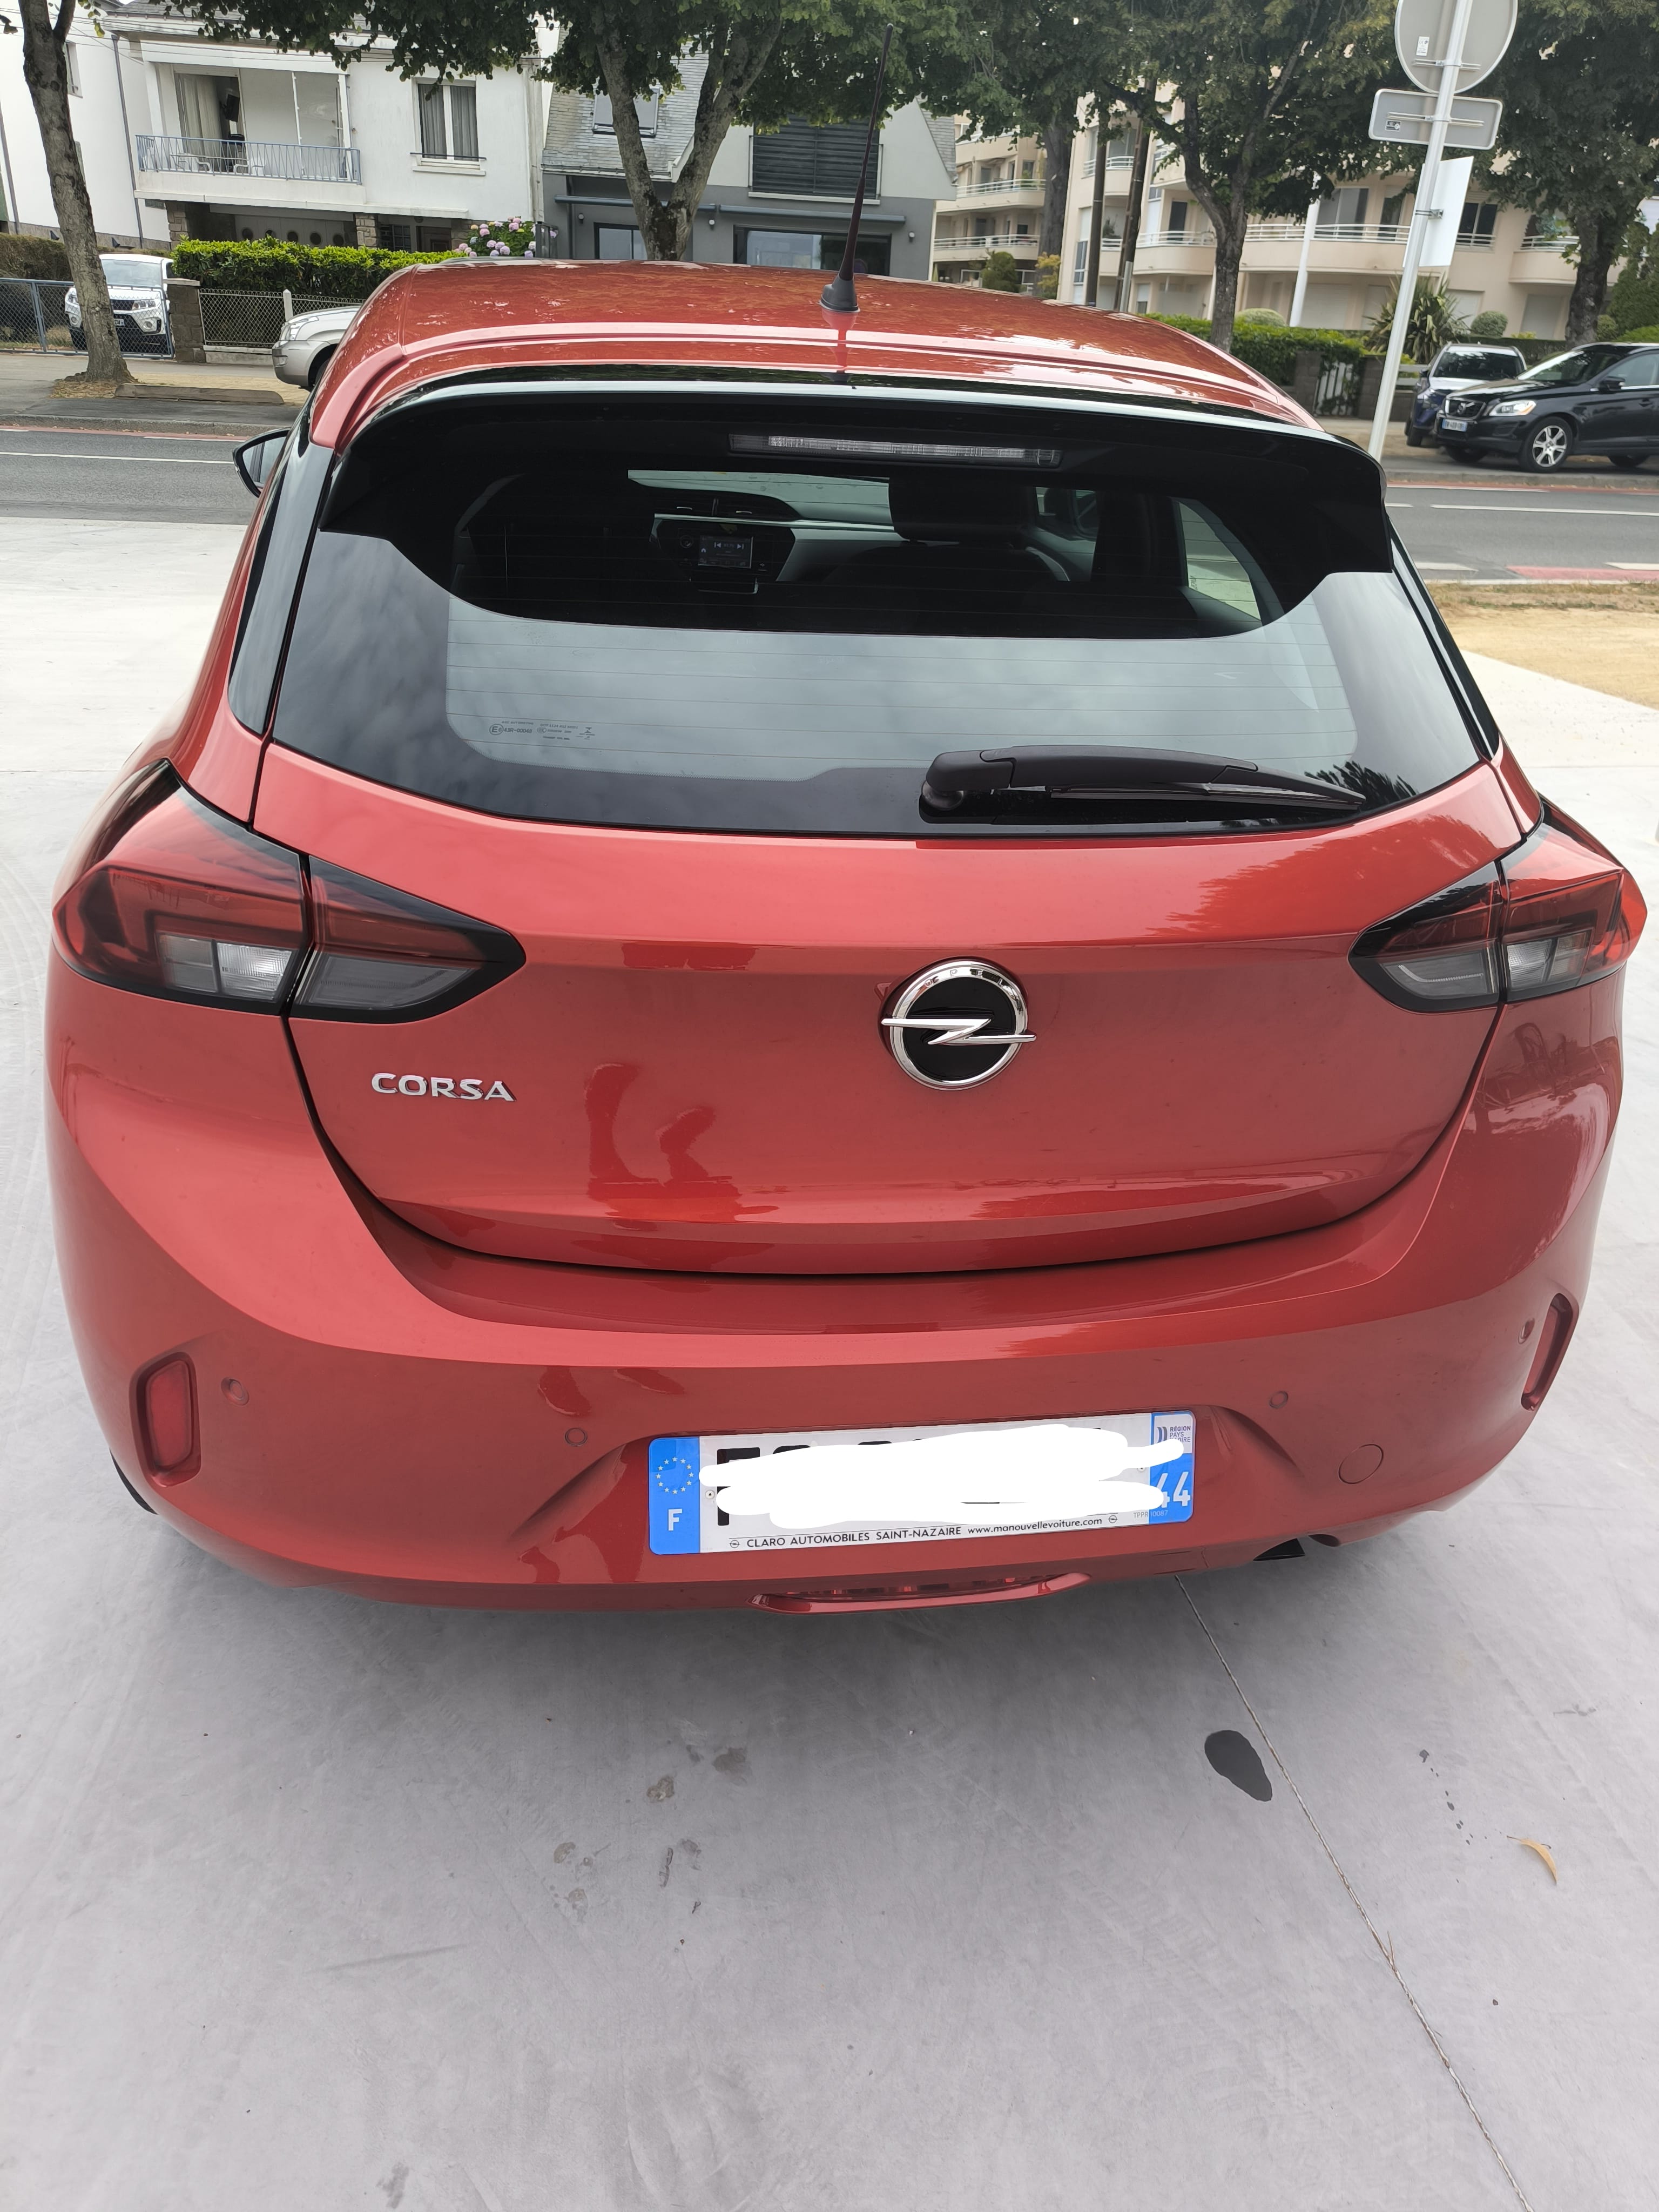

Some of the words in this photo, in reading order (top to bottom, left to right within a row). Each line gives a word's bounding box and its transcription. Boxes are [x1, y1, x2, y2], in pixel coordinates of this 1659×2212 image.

[372, 1073, 517, 1101] CORSA
[1156, 1471, 1191, 1508] 44
[668, 1508, 683, 1531] F
[746, 1537, 786, 1548] CLARO
[790, 1532, 870, 1545] AUTOMOBILES
[875, 1526, 962, 1540] SAINT-NAZAIRE
[967, 1517, 1103, 1534] www.manouvellevoiture.com
